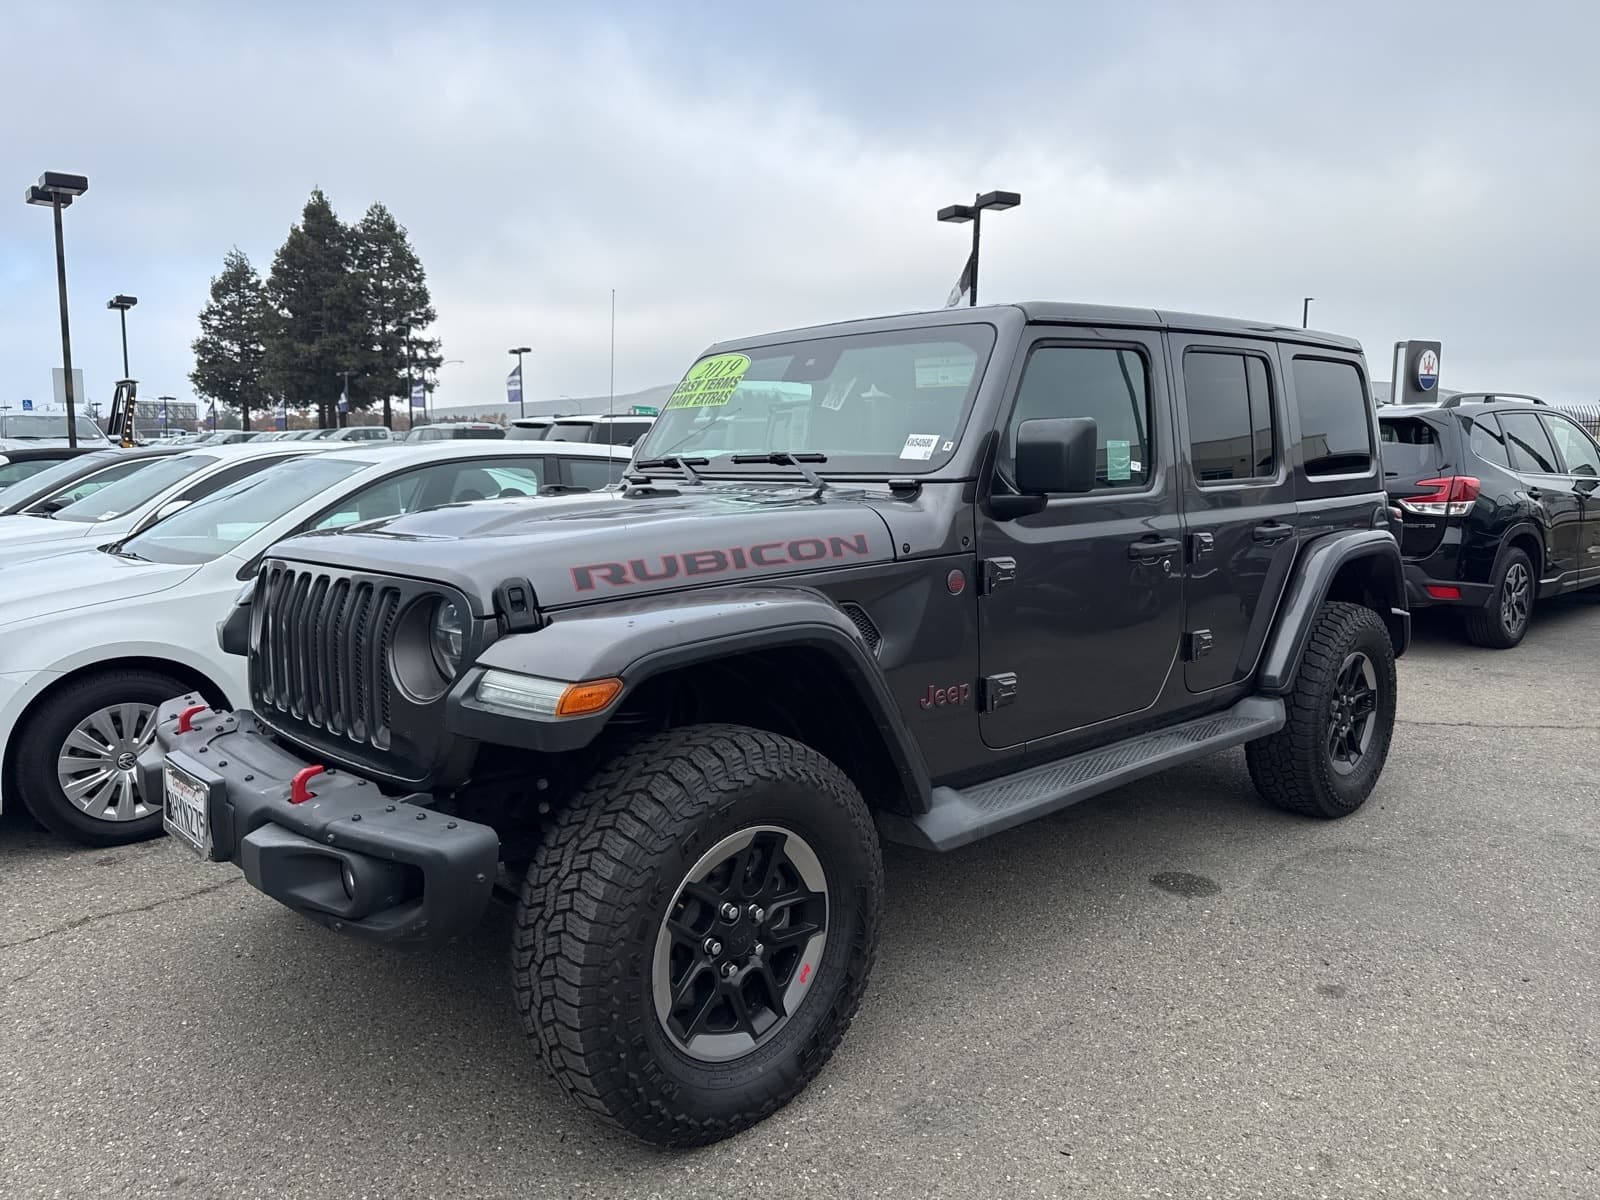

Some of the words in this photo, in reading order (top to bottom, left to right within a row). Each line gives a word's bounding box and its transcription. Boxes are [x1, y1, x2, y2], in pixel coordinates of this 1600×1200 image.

[694, 359, 743, 379] 2019
[703, 375, 742, 391] TERMS
[692, 390, 732, 405] EXTRAS
[569, 534, 870, 592] RUBICON
[919, 683, 968, 709] Jeep
